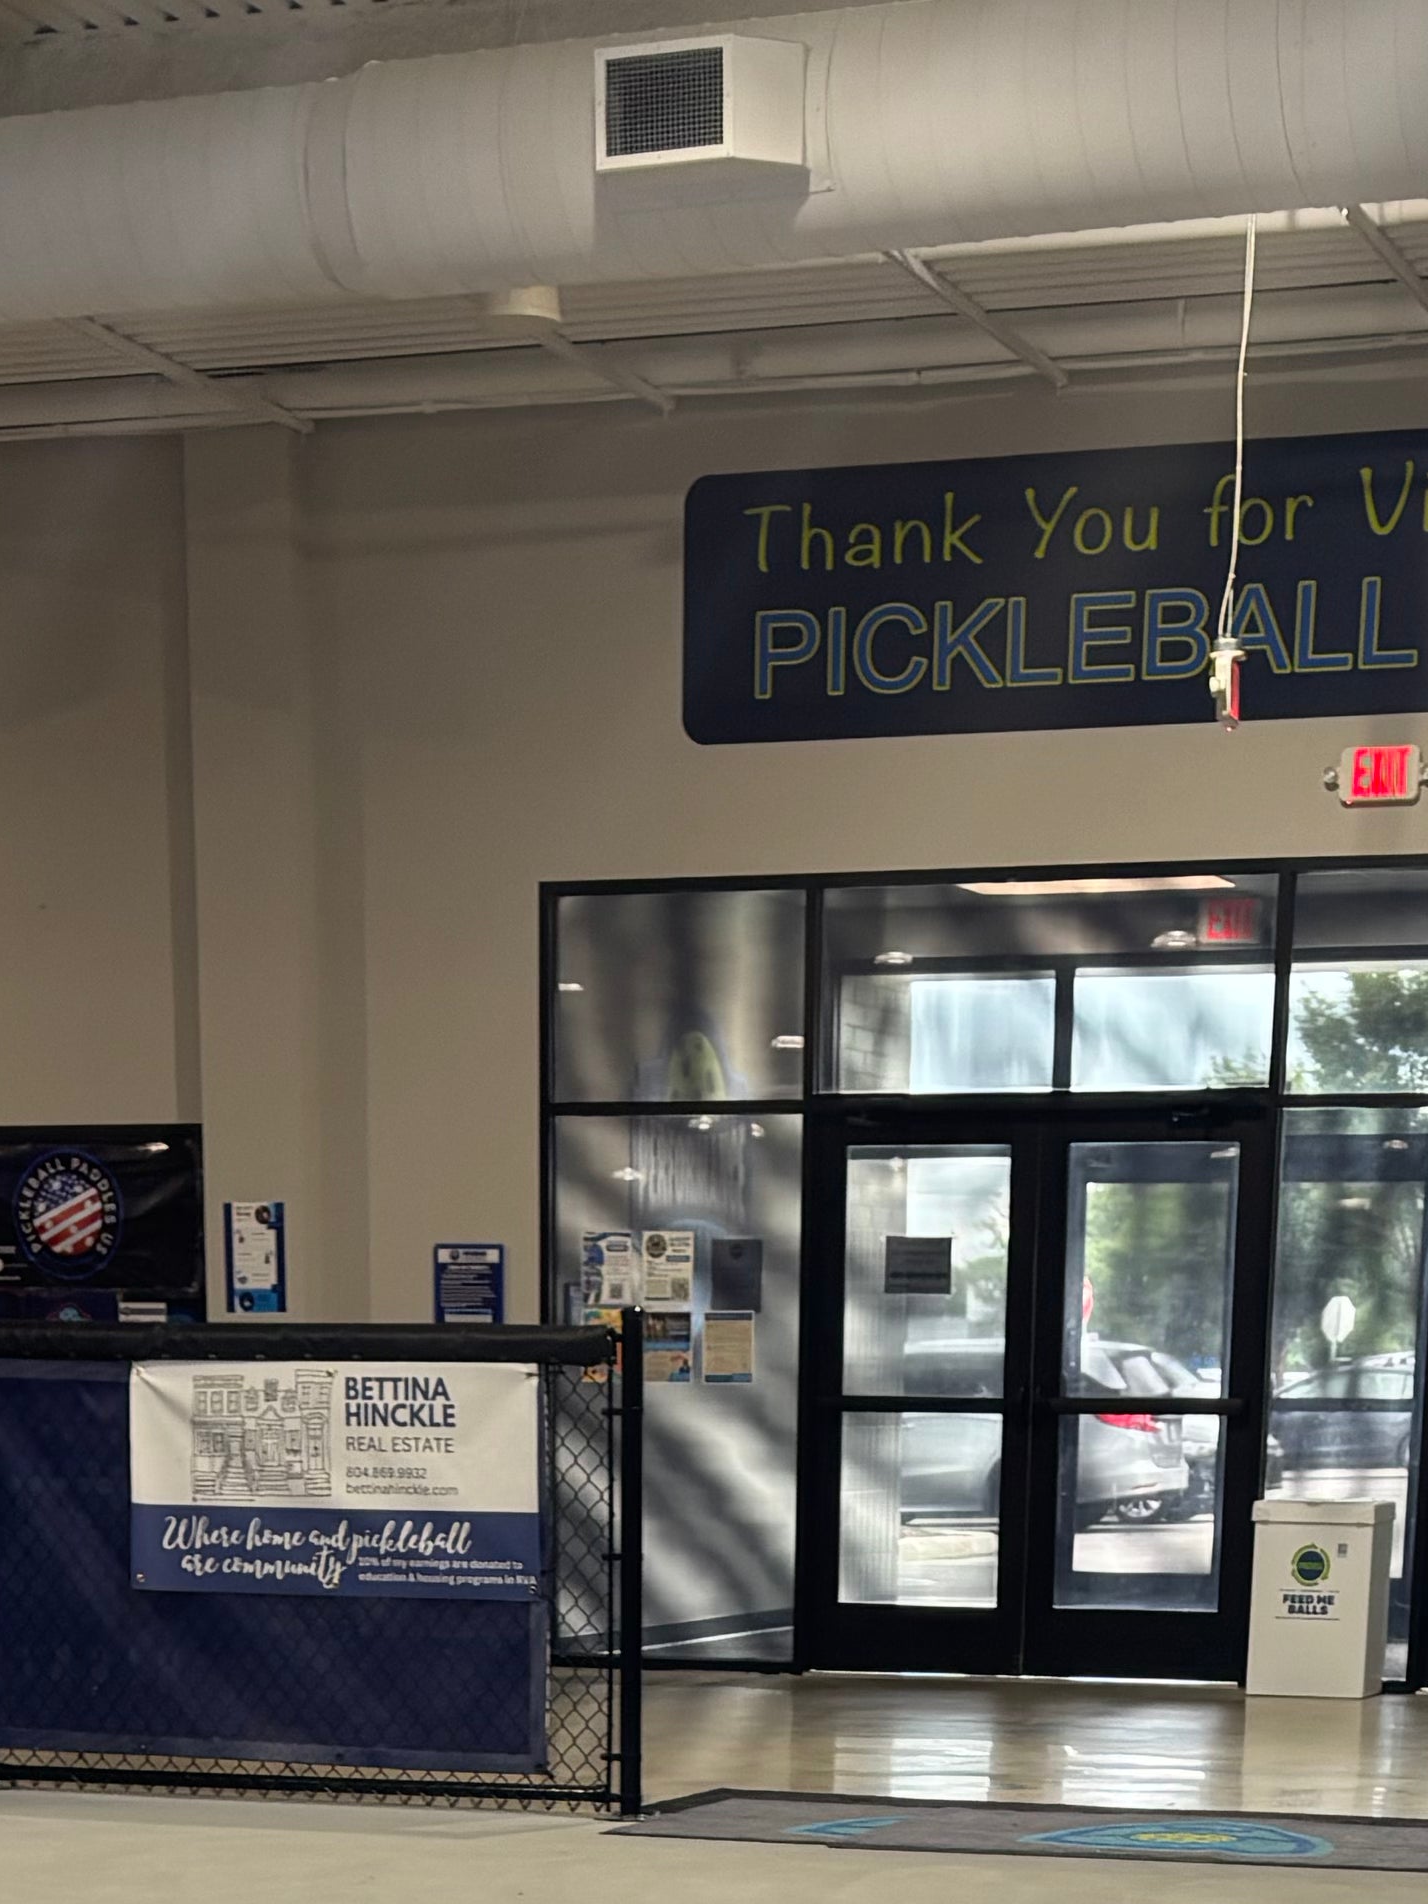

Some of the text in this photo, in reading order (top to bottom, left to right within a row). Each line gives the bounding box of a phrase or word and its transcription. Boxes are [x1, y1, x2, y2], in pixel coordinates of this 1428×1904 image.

[743, 491, 983, 573] Thank
[1025, 486, 1160, 559] You
[1204, 473, 1313, 547] for
[753, 575, 1418, 699] PICKLEBALL
[1351, 745, 1413, 798] EXIT
[1207, 897, 1256, 940] EXIT
[345, 1376, 452, 1401] BETTINA
[345, 1402, 457, 1428] HINCKLE
[345, 1436, 456, 1454] REAL ESTATE
[345, 1483, 459, 1496] bettinahinckle.com
[162, 1514, 472, 1566] Where home and pickleball
[181, 1546, 348, 1589] are community
[1282, 1593, 1336, 1606] FEED ME
[1287, 1604, 1329, 1616] BALLS
